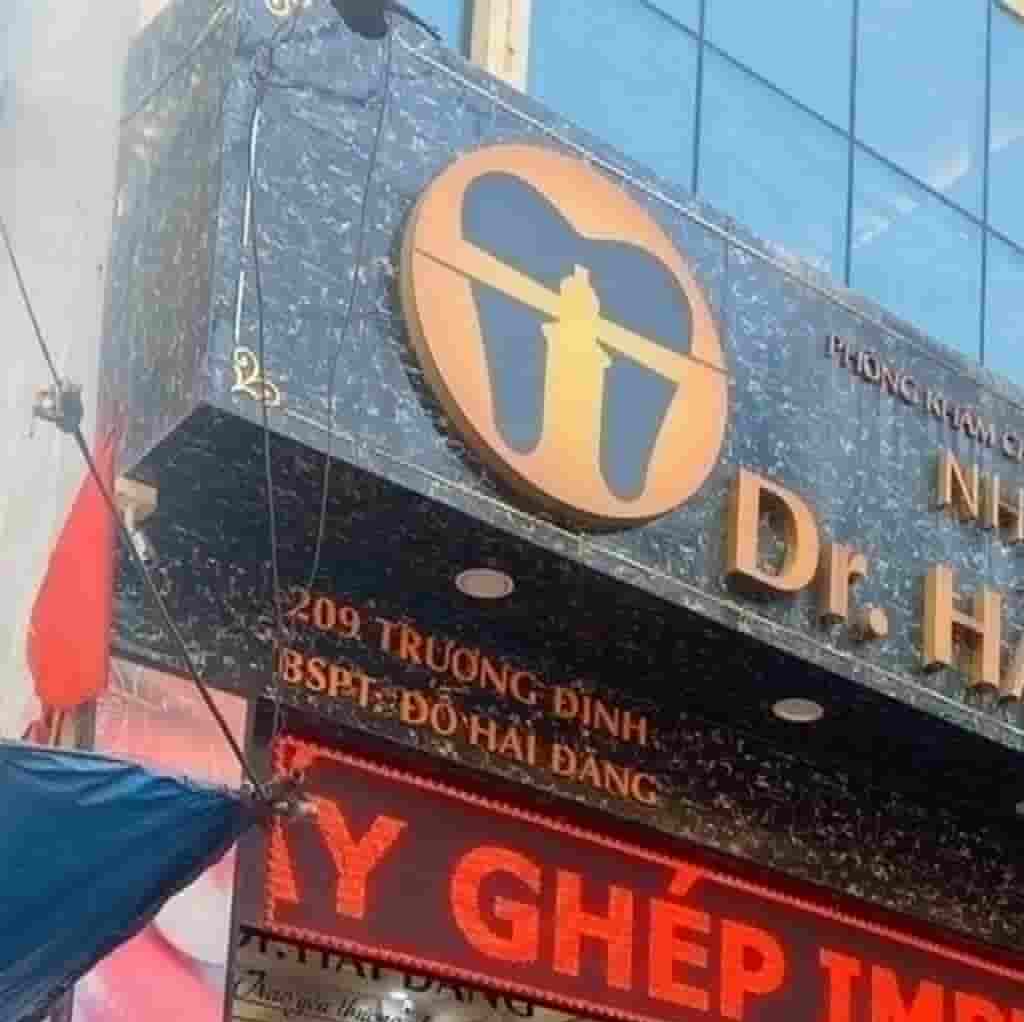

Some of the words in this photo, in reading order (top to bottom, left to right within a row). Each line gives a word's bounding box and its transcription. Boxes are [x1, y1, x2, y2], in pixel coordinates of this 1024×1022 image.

[725, 467, 890, 643] Dr.
[287, 584, 361, 641] 209
[552, 684, 648, 745] ĐỊNH
[468, 711, 537, 768] HẢI
[551, 741, 658, 806] ĐĂNG
[446, 842, 787, 1022] GHÉP
